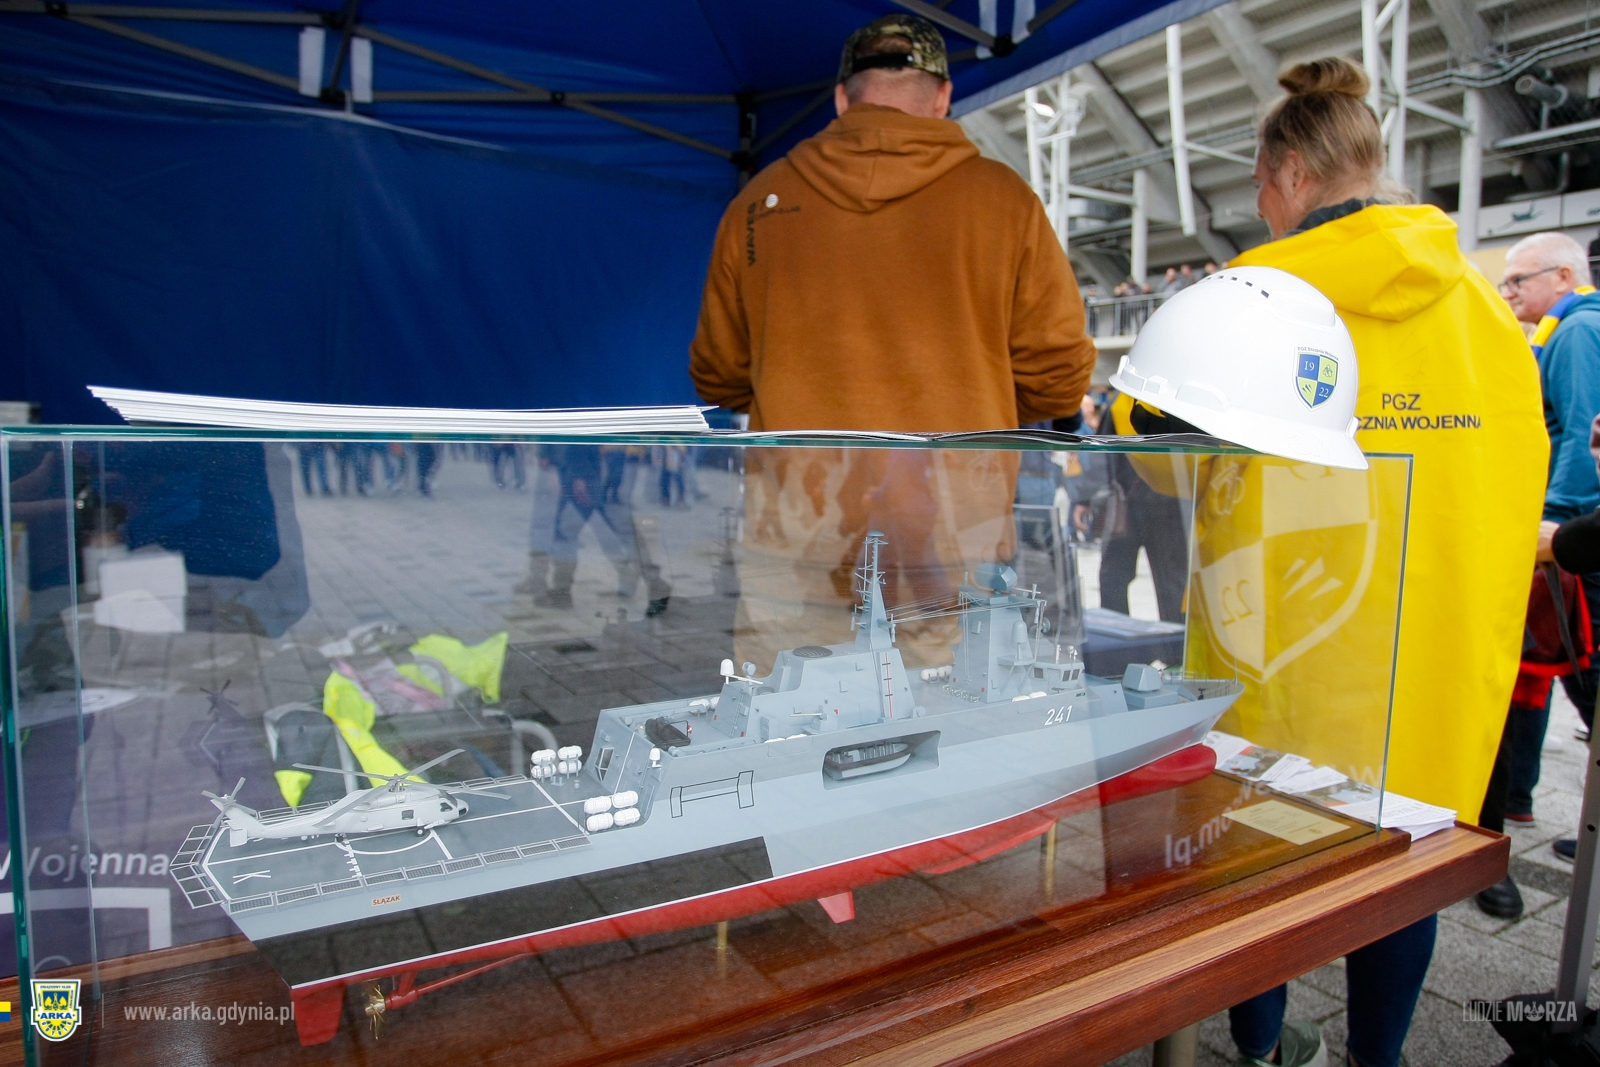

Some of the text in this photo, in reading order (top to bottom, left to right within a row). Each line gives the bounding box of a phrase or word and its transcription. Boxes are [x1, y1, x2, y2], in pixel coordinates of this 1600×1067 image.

[1304, 361, 1315, 371] 19
[1319, 387, 1329, 398] 22
[1382, 393, 1421, 411] PGZ
[1044, 705, 1073, 726] 241
